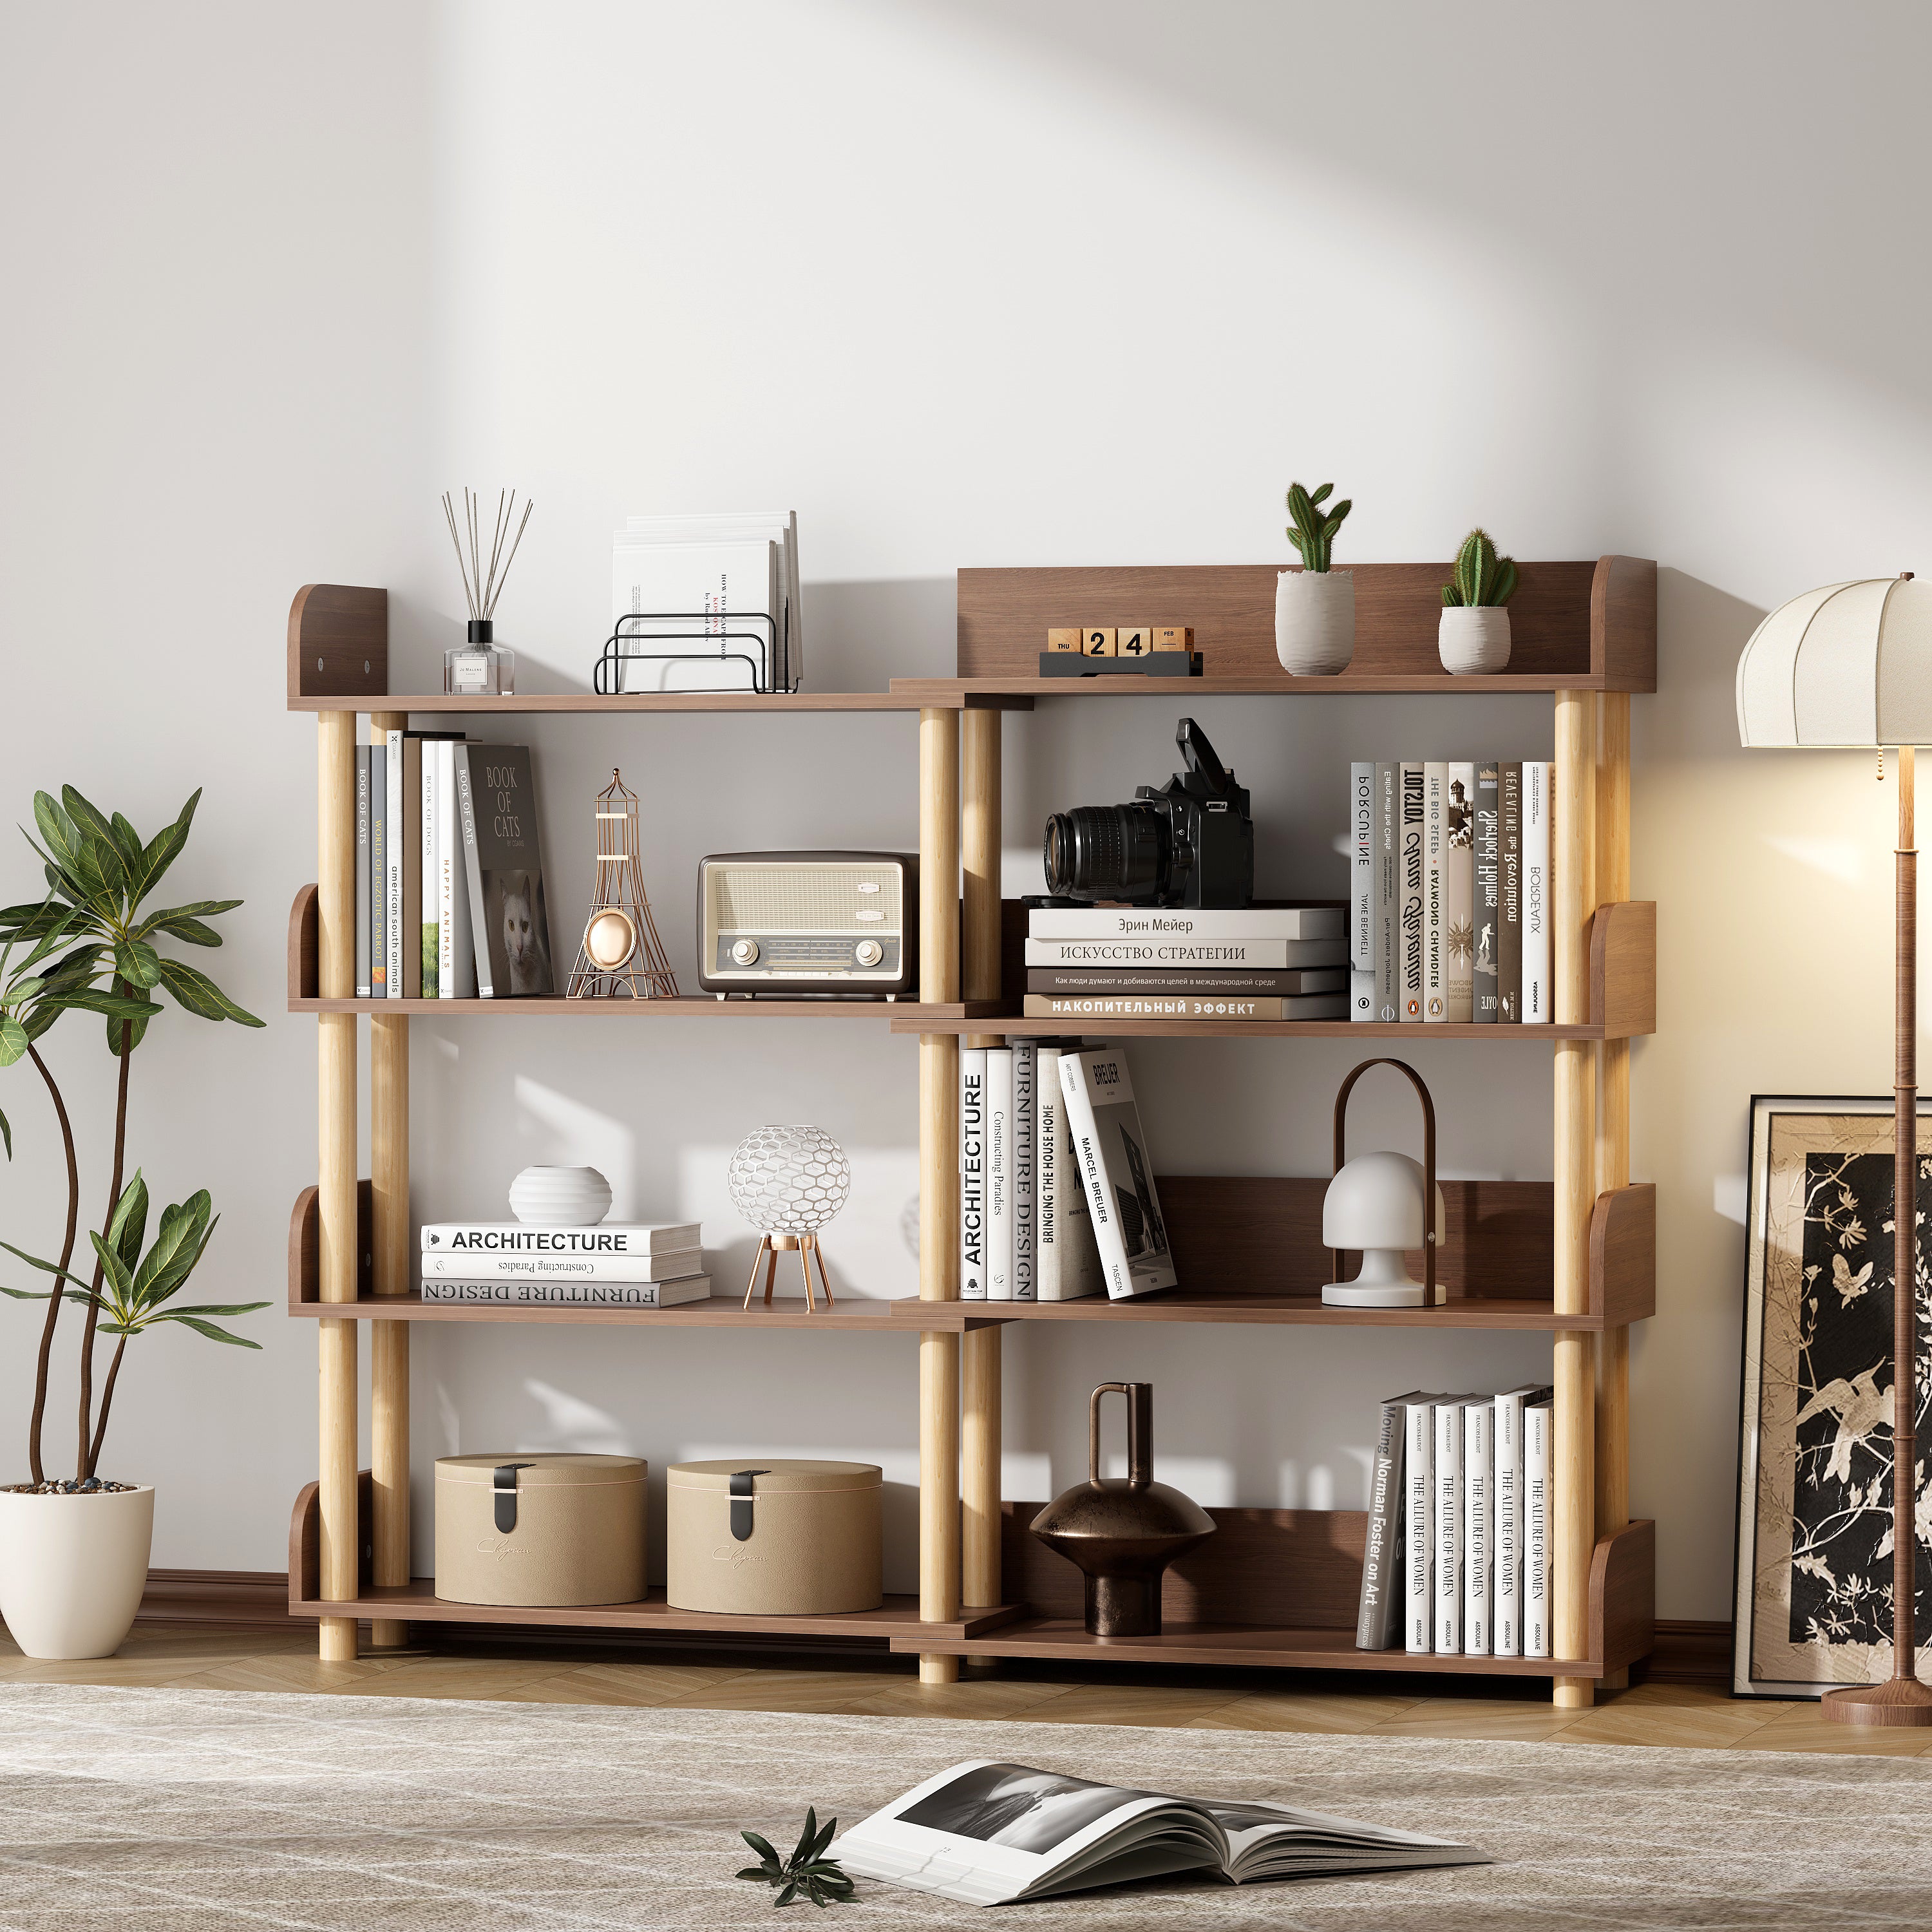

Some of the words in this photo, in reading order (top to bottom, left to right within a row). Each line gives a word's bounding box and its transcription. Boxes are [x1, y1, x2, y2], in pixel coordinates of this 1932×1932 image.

[721, 594, 726, 605] TO
[1090, 632, 1104, 655] 2
[1126, 634, 1142, 655] 4
[459, 769, 469, 799] BOOK
[486, 766, 517, 788] BOOK
[359, 802, 366, 815] OF
[463, 802, 471, 815] OF
[497, 791, 511, 812] OF
[426, 809, 431, 822] OF
[494, 816, 520, 837] CATS
[465, 820, 474, 844] CATS
[375, 859, 382, 872] OF
[1118, 918, 1148, 934] Эрин
[1152, 918, 1193, 934] Мейер
[1060, 947, 1153, 960] ИСКУССТВО
[1157, 947, 1246, 960] СТРАТЕГИИ
[1068, 977, 1088, 985] люди
[1088, 978, 1115, 986] думают
[1166, 977, 1188, 985] целей
[1195, 977, 1253, 987] международной
[1052, 999, 1186, 1013] НАКОПИТЕЛЬНЫЙ
[1194, 1002, 1255, 1014] ЭФФЕКТ
[1093, 1063, 1121, 1085] BREUER
[1018, 1045, 1030, 1195] FURNITURE
[1043, 1104, 1053, 1134] HOME
[992, 1111, 1004, 1173] Constructing
[1043, 1136, 1053, 1170] HOUSE
[965, 1074, 980, 1265] ARCHITECTURE
[1081, 1137, 1094, 1180] MARCEL
[1091, 1182, 1108, 1224] BREUER
[1043, 1171, 1053, 1192] THE
[994, 1175, 1004, 1216] Paradies
[1043, 1195, 1053, 1243] BRINGING
[452, 1232, 627, 1251] ARCHITECTURE
[1018, 1203, 1030, 1298] DESIGN
[498, 1262, 535, 1273] Paradies
[538, 1260, 594, 1274] Constructing
[1111, 1264, 1122, 1292] TASCEN
[424, 1284, 510, 1300] DESIGN
[518, 1287, 656, 1303] FURNITURE
[1377, 1406, 1396, 1455] Moving
[1374, 1458, 1392, 1513] Norman
[1414, 1475, 1424, 1496] THE
[1443, 1476, 1454, 1497] THE
[1473, 1477, 1483, 1497] THE
[1502, 1469, 1513, 1491] THE
[1533, 1479, 1543, 1499] THE
[1414, 1499, 1424, 1537] ALLURE
[1443, 1499, 1454, 1539] ALLURE
[1473, 1500, 1483, 1539] ALLURE
[1502, 1493, 1513, 1535] ALLURE
[1533, 1502, 1543, 1541] ALLURE
[1370, 1517, 1387, 1560] Foster
[1414, 1540, 1424, 1554] OF
[1443, 1541, 1454, 1555] OF
[1473, 1542, 1483, 1556] OF
[1502, 1538, 1513, 1552] OF
[1533, 1544, 1543, 1558] OF
[1367, 1564, 1379, 1581] on
[1414, 1556, 1424, 1596] WOMEN
[1443, 1557, 1454, 1596] WOMEN
[1473, 1558, 1483, 1598] WOMEN
[1502, 1555, 1513, 1596] WOMEN
[1533, 1560, 1543, 1600] WOMEN
[1365, 1584, 1379, 1606] Art
